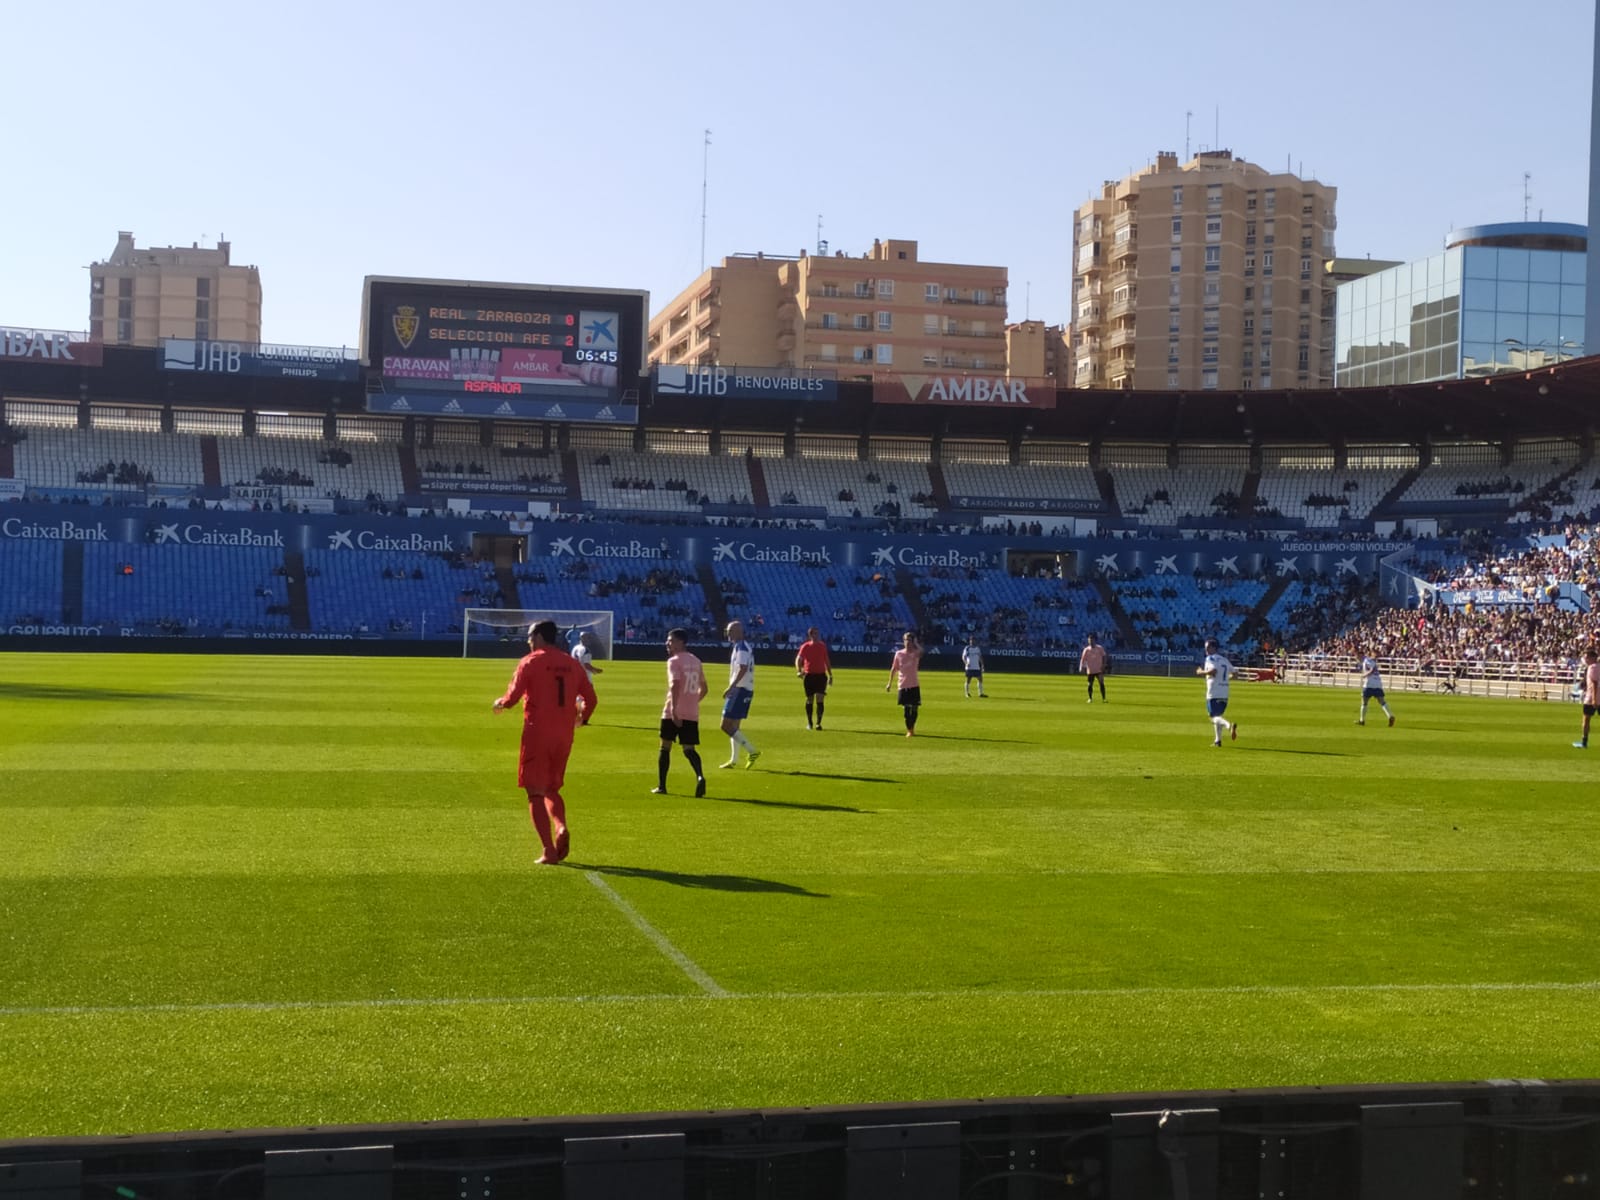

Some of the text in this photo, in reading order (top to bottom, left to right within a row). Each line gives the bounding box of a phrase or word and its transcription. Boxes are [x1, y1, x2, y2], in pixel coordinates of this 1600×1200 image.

[429, 307, 575, 326] REAL ZARAGOZA 0
[0, 330, 75, 360] BAR
[429, 328, 575, 347] SELECCION AFE 2
[197, 340, 241, 373] JAB
[383, 357, 450, 372] CARAVAN
[575, 349, 618, 363] 06:45
[282, 367, 318, 378] PHILIPS
[512, 361, 549, 373] AMBAR
[688, 367, 825, 396] JAB RENOVABLES
[927, 377, 1032, 405] AMBAR
[2, 518, 109, 541] CaixaBank
[184, 524, 285, 547] CaixaBank
[357, 530, 454, 552] CaixaBank
[578, 538, 664, 559] CaixaBan
[1280, 542, 1312, 552] JUEGO
[1366, 542, 1411, 552] VIOLENCIA
[739, 542, 833, 563] CaixaBank
[990, 648, 1026, 656] avanza
[1041, 650, 1078, 658] avanza
[1160, 654, 1194, 662] mazda
[1220, 664, 1228, 681] 7
[555, 675, 565, 707] 1
